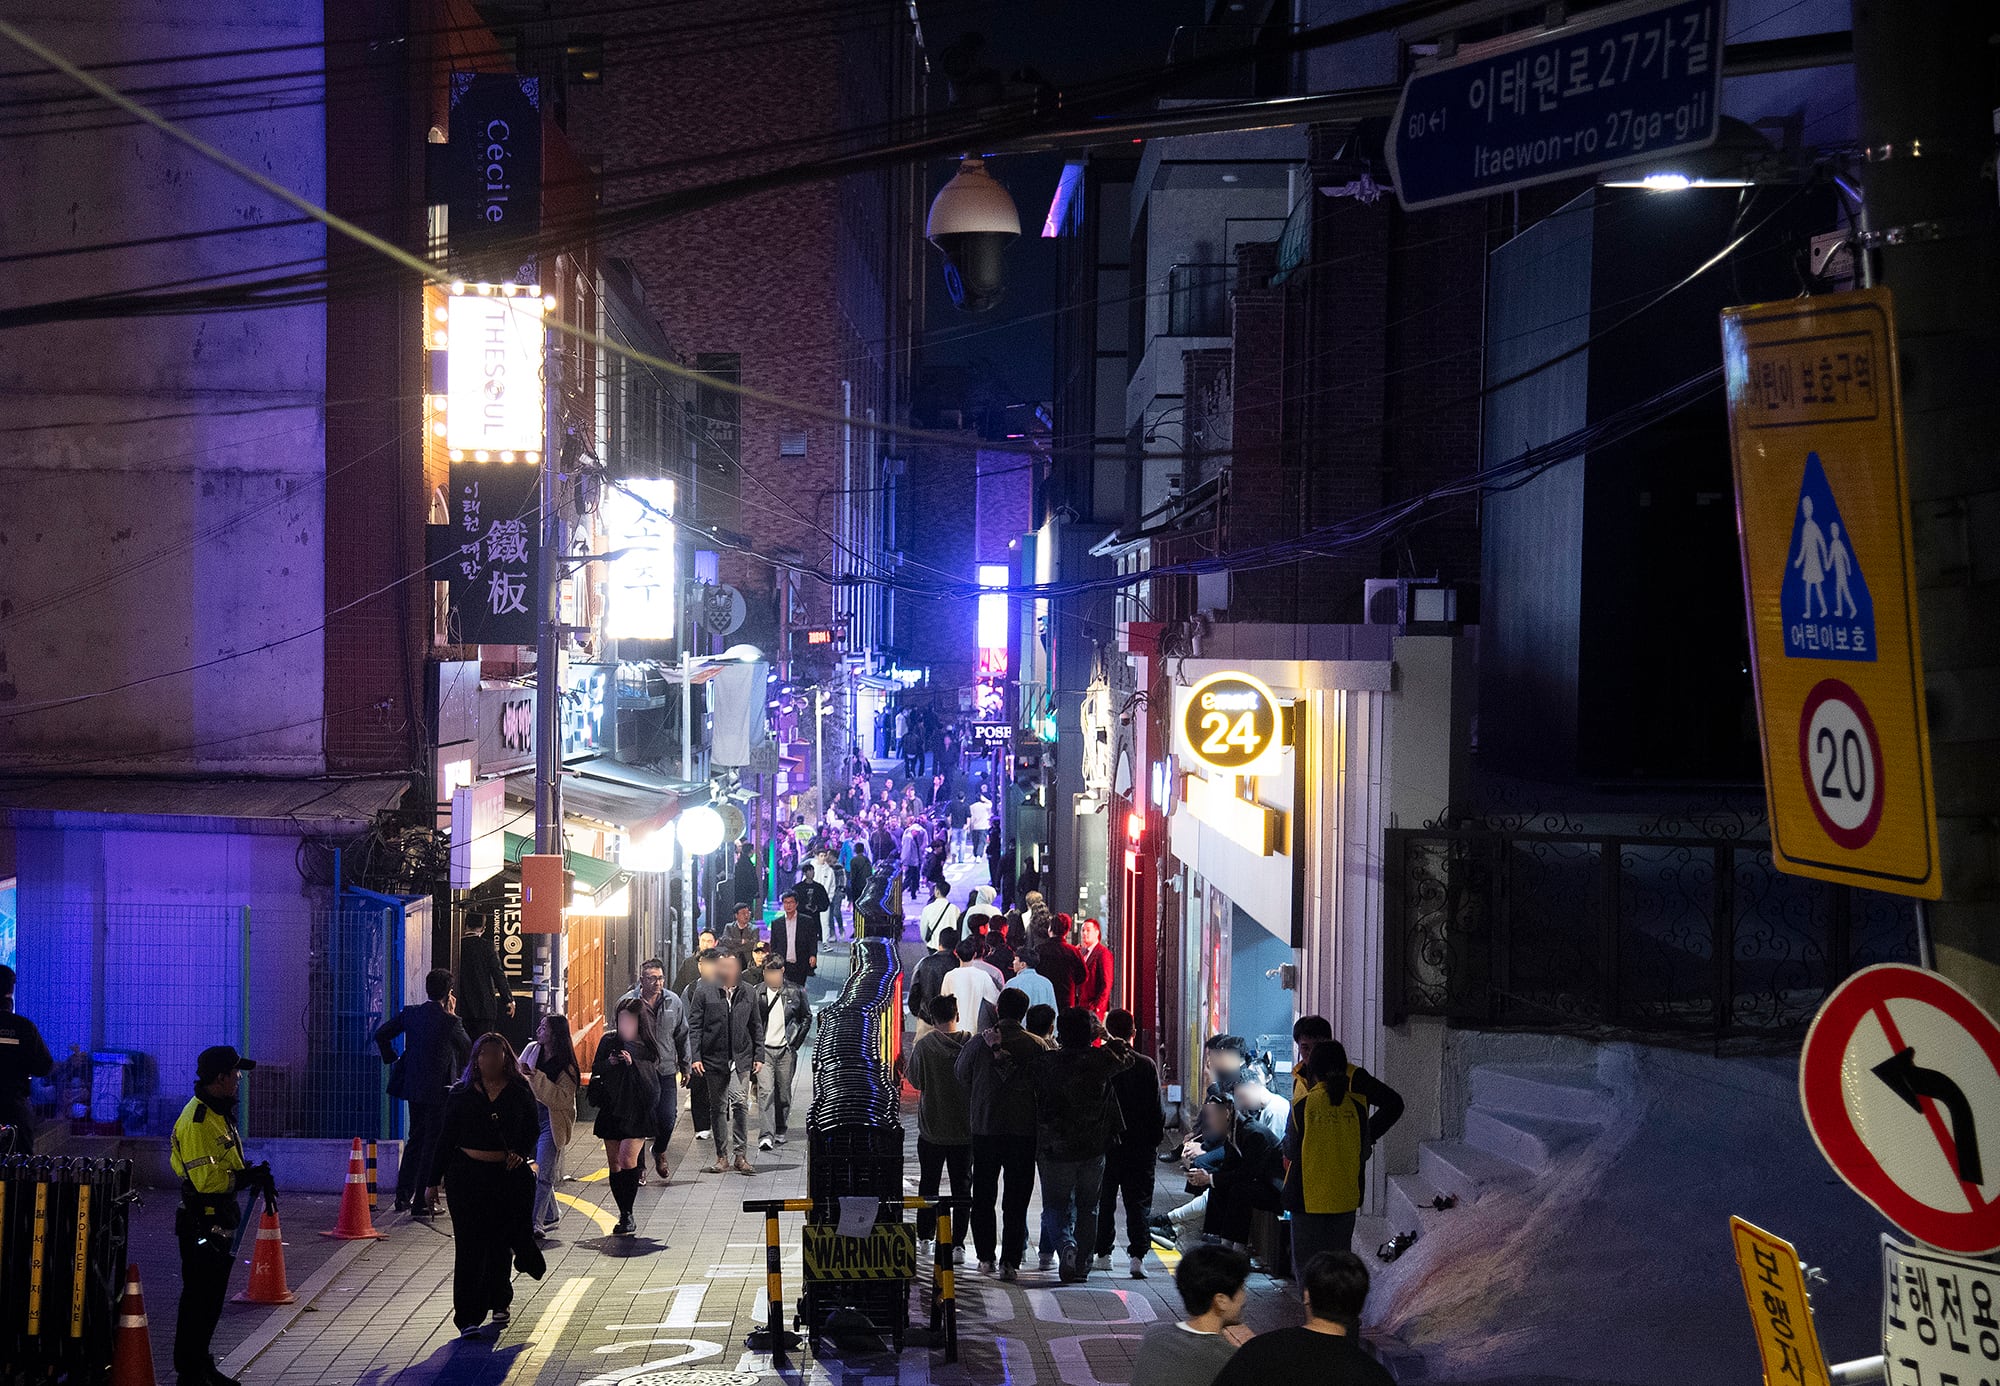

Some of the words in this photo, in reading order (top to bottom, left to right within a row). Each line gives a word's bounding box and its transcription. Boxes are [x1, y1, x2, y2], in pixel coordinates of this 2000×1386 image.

[1468, 6, 1712, 123] 이태원로27가길
[1408, 112, 1426, 140] 60
[1473, 127, 1599, 178] Itaewon-ro
[1604, 91, 1706, 150] 27ga-gil
[486, 119, 512, 223] Cécile
[484, 310, 506, 436] THESOUL
[462, 481, 481, 533] 이태원
[487, 519, 529, 616] 鐵板
[623, 508, 661, 602] 소주
[1790, 622, 1868, 653] 어린이보호
[1201, 711, 1261, 754] 24
[1815, 727, 1866, 802] 20
[76, 1211, 87, 1272] POLICE
[814, 1234, 906, 1269] WARNING
[73, 1283, 82, 1322] LINE
